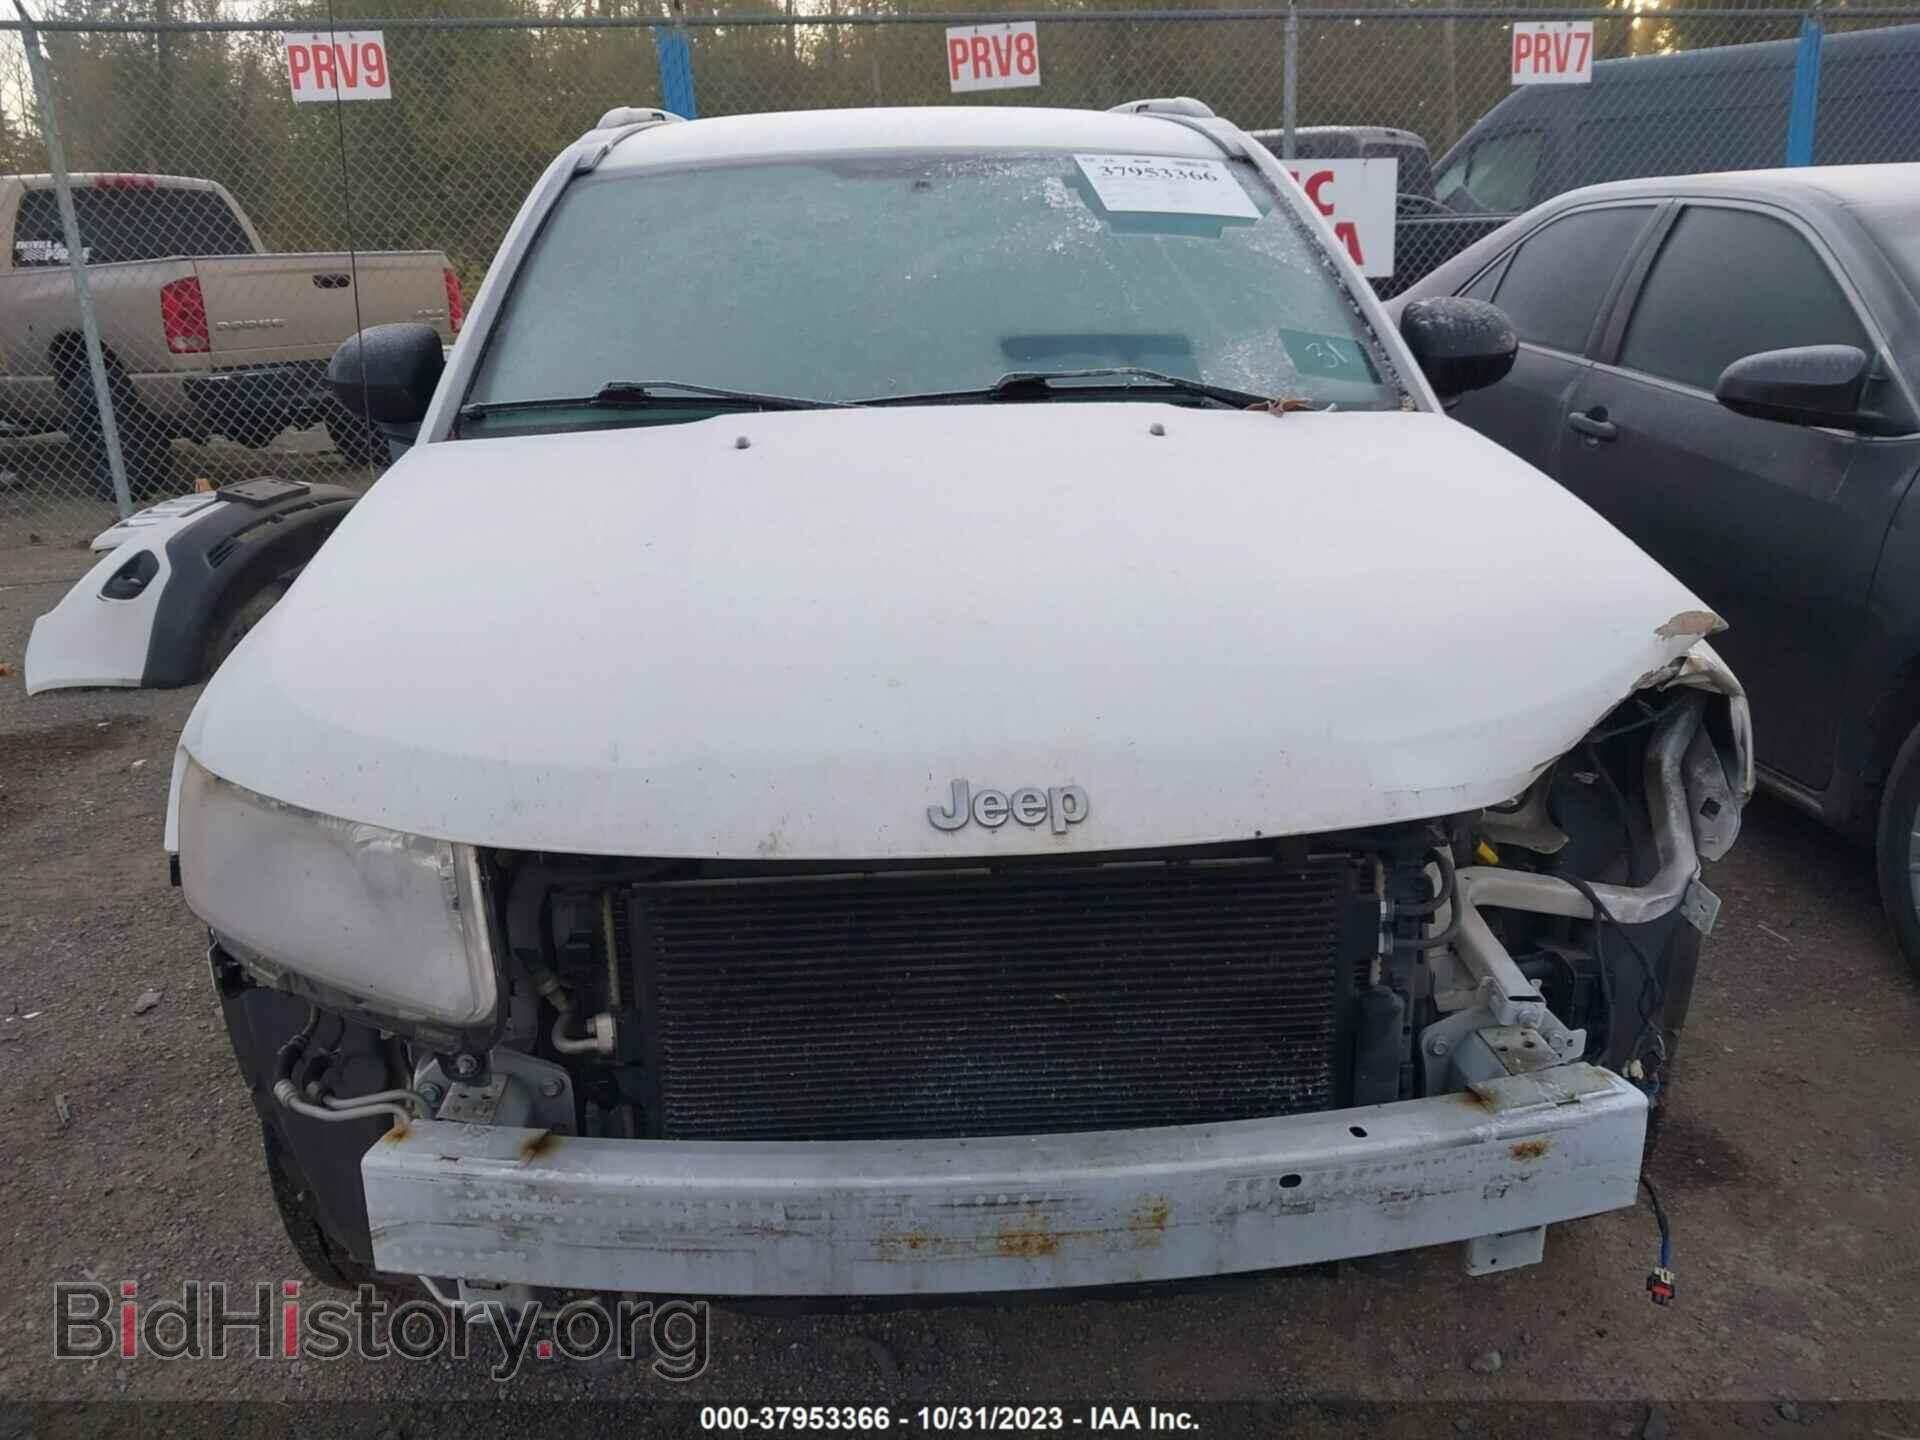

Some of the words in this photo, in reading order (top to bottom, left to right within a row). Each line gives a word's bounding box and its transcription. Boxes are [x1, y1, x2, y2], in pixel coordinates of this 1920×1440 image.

[288, 43, 386, 90] PRV9
[949, 32, 1037, 81] PRV8
[1514, 32, 1591, 74] PRV7
[1100, 165, 1219, 183] 37953366
[927, 777, 1090, 836] Jeep
